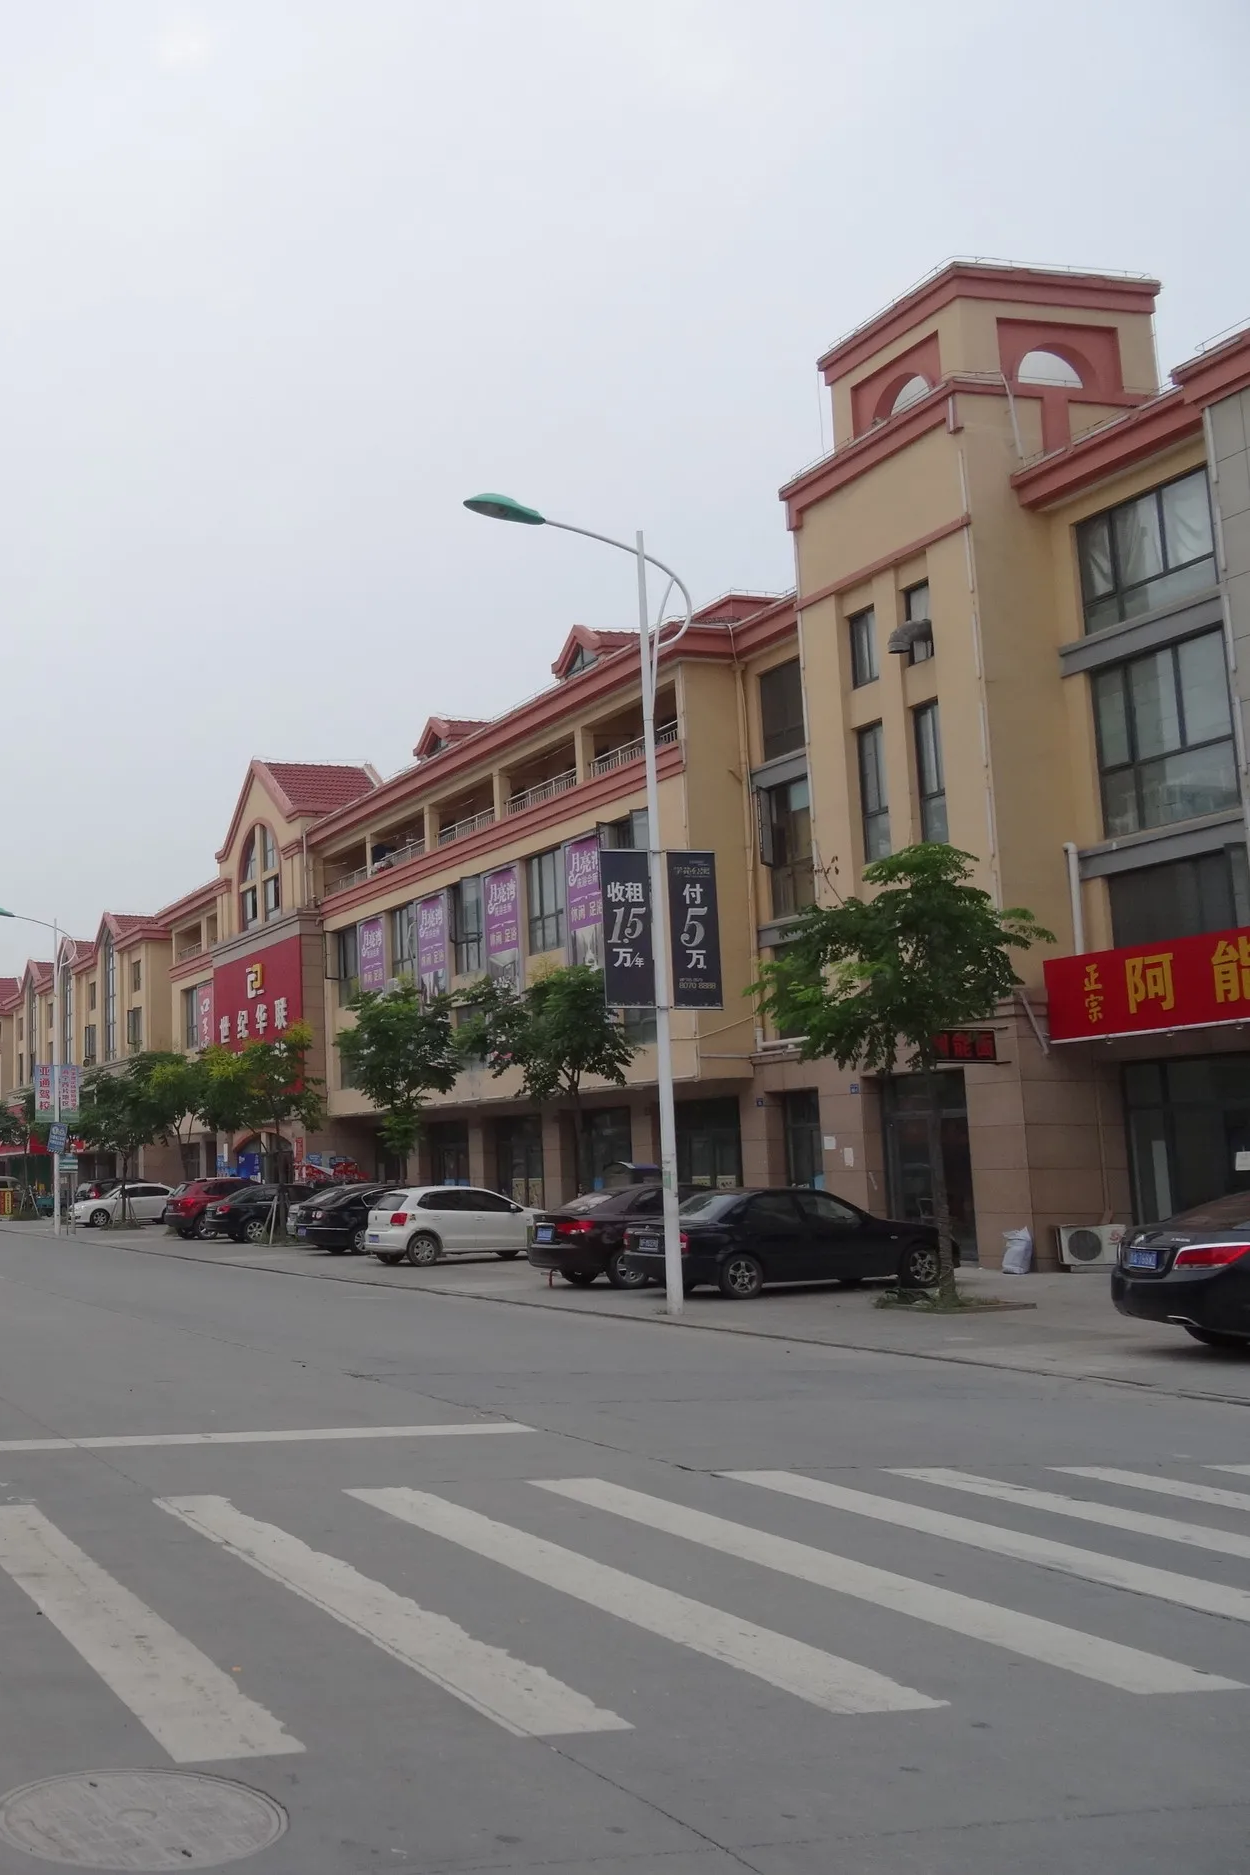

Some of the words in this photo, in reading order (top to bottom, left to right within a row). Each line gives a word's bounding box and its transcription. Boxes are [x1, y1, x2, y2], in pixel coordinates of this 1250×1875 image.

[487, 878, 516, 915] 月亮湾
[606, 882, 644, 903] 收租
[682, 883, 703, 904] 付
[607, 907, 646, 944] 1.5
[680, 906, 708, 947] 5
[613, 948, 645, 968] 万/年
[1124, 936, 1250, 1014] 阿能
[1083, 963, 1104, 1024] 正宗
[219, 996, 288, 1044] 世纪华联
[39, 1066, 50, 1111] 亚通驾校
